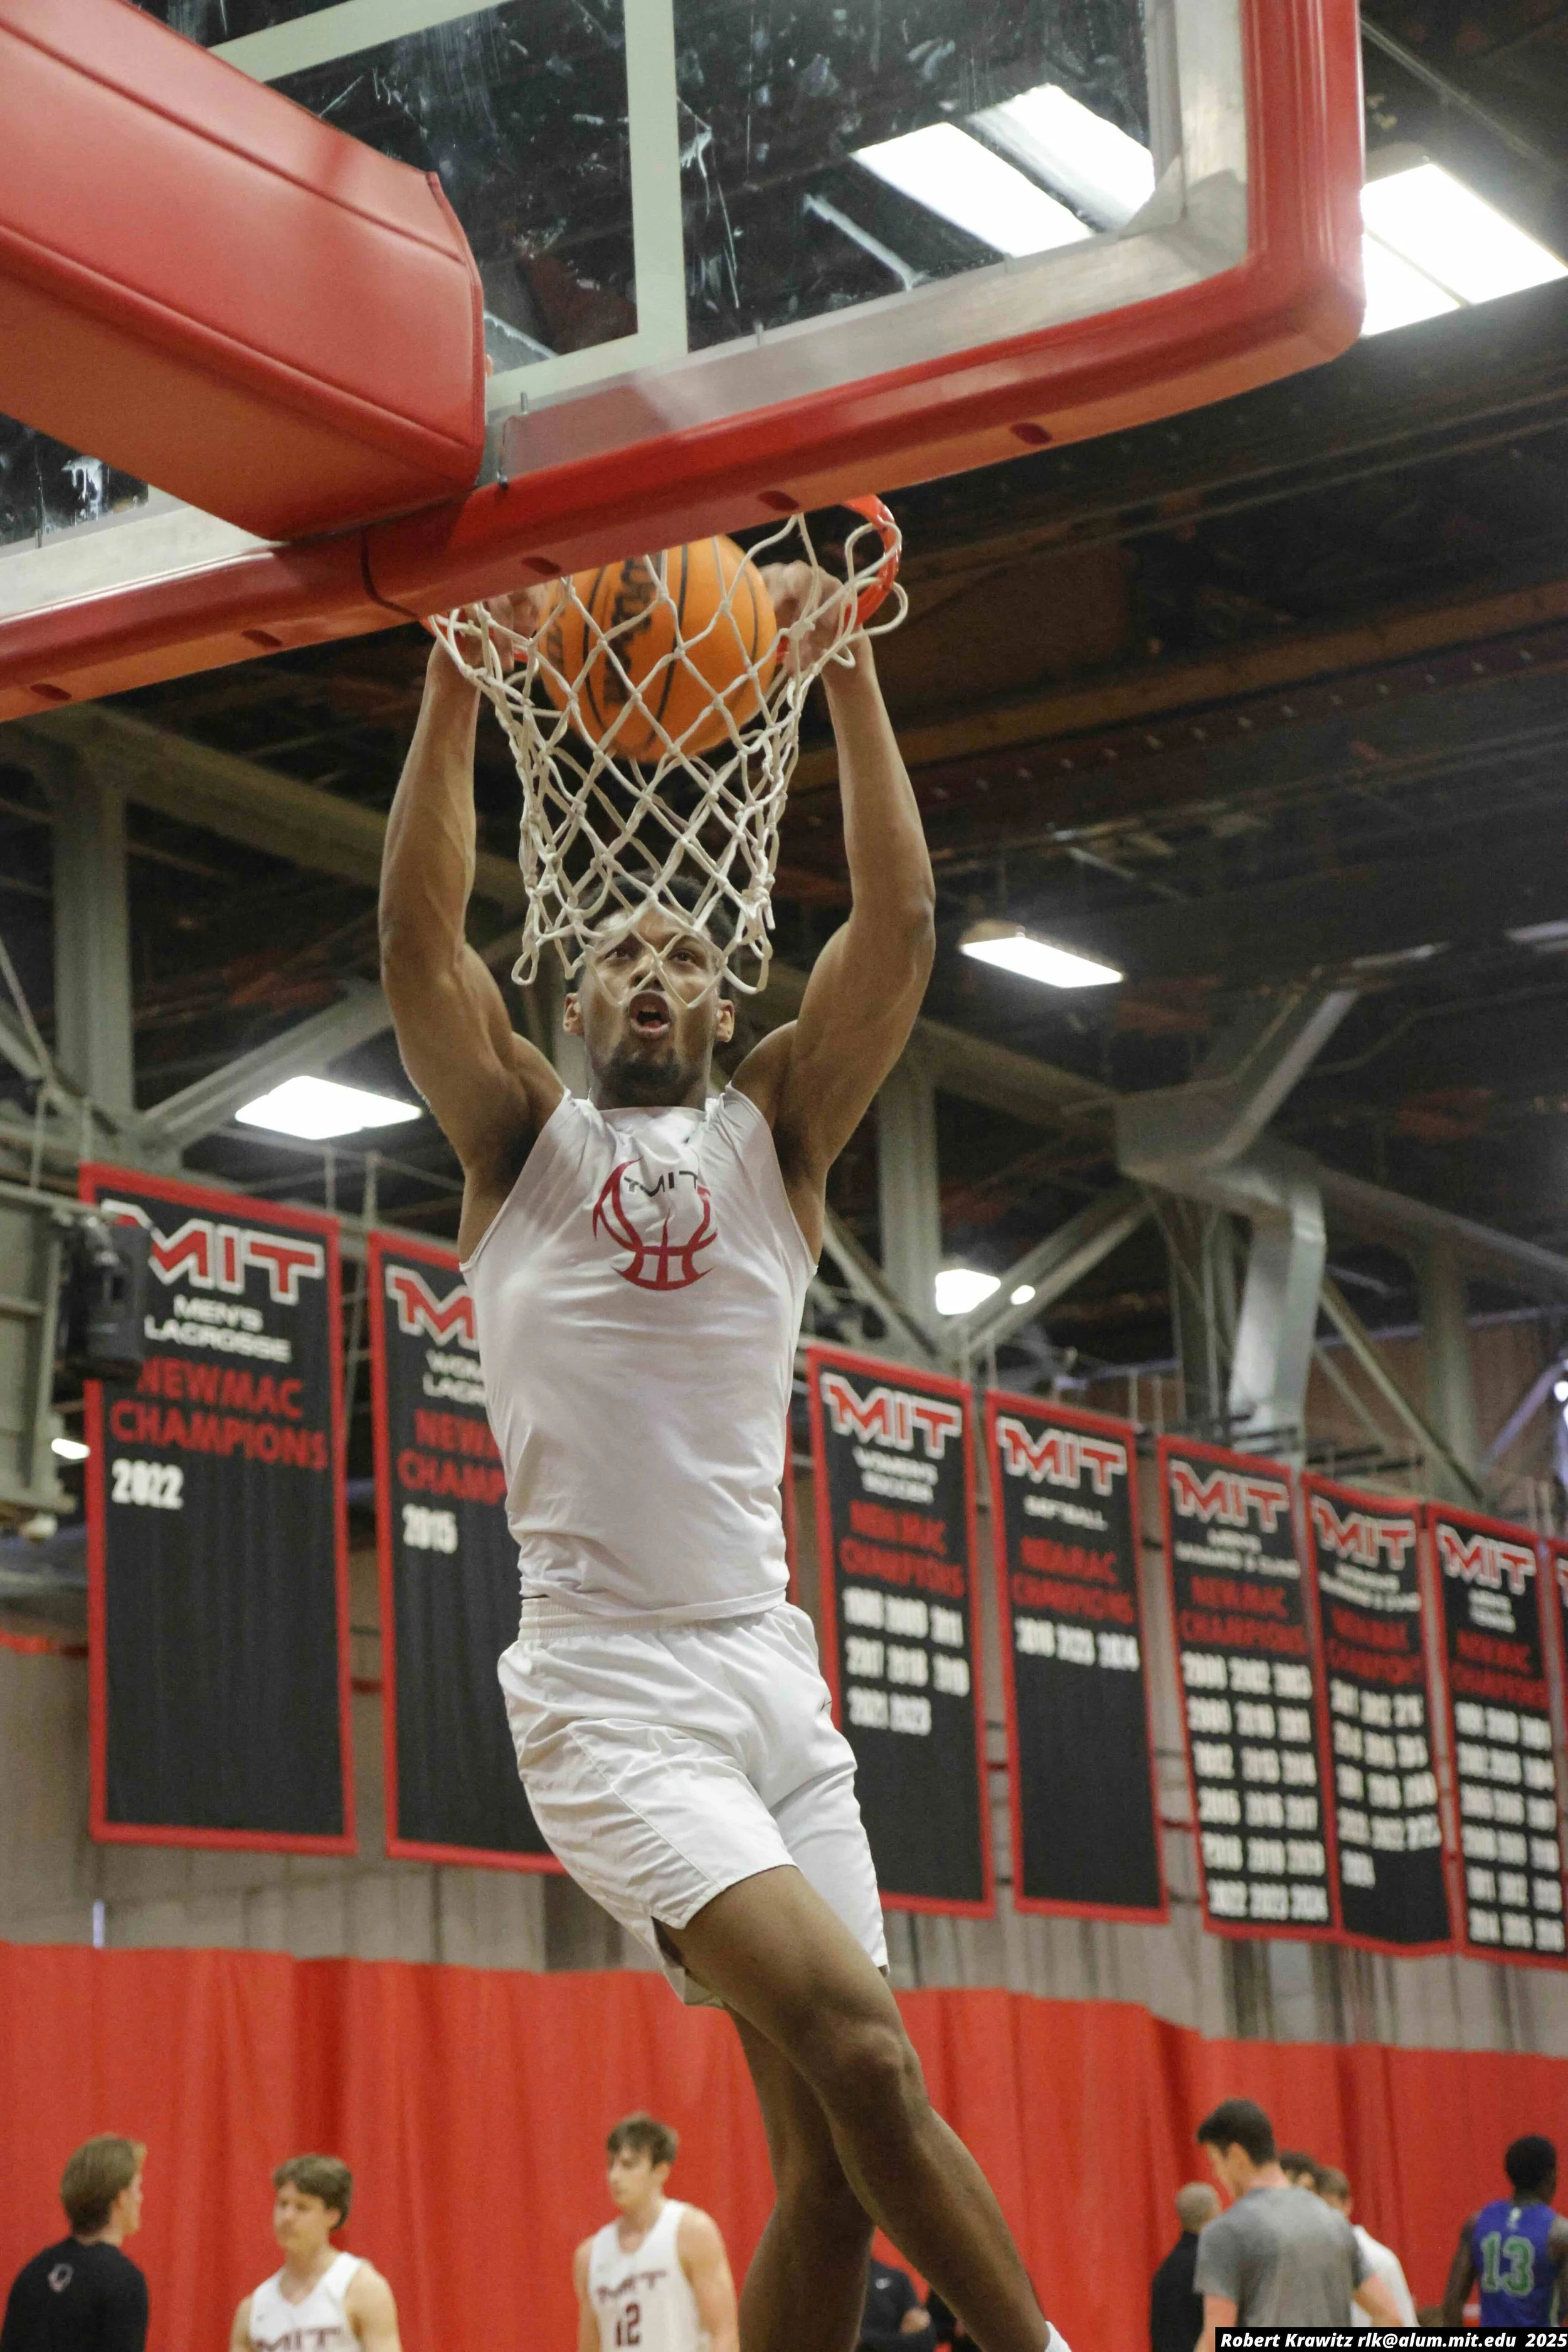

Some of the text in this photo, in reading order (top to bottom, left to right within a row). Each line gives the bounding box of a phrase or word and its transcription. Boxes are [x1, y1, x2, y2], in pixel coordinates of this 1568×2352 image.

[100, 1198, 324, 1305] MIT
[144, 1315, 292, 1363] LACROSSE
[174, 1294, 263, 1333] MEN'S
[136, 1356, 304, 1419] NEWMAC
[819, 1371, 963, 1461] MIT
[110, 1400, 327, 1470] CHAMPIONS
[996, 1416, 1128, 1496] MIT
[112, 1458, 184, 1510] 2022
[1170, 1458, 1290, 1534] MIT
[1311, 1495, 1416, 1570] MIT
[1436, 1523, 1537, 1596] MIT
[839, 1536, 966, 1599] CHAMPIONS
[1012, 1572, 1134, 1624] CHAMPIONS
[1480, 2231, 1535, 2296] 13
[615, 2302, 642, 2347] 12
